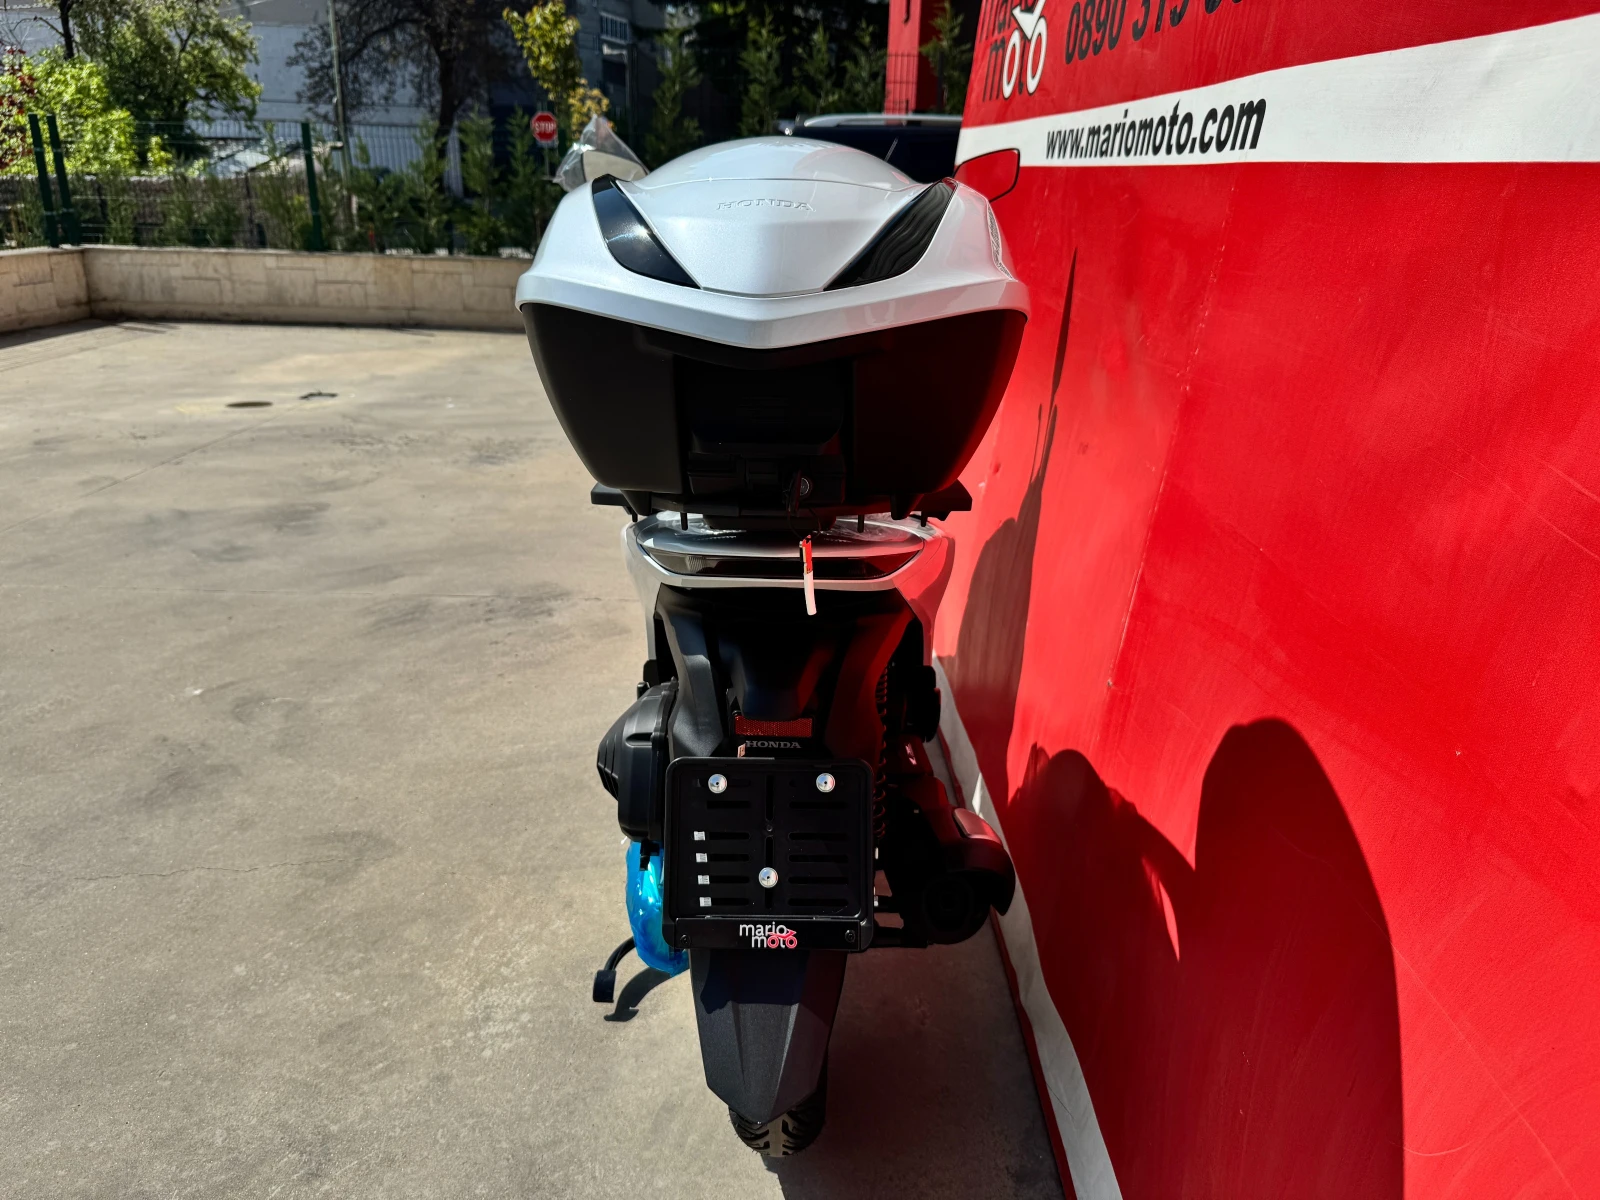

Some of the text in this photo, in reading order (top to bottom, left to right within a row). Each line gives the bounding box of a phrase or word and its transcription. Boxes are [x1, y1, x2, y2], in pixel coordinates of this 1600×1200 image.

[1065, 0, 1126, 65] 0890
[534, 121, 557, 133] STOP
[1045, 98, 1267, 160] www.mariomoto.com
[716, 198, 816, 213] HONDA
[745, 740, 802, 749] HONDA
[739, 921, 788, 937] mario
[751, 935, 798, 949] moto
